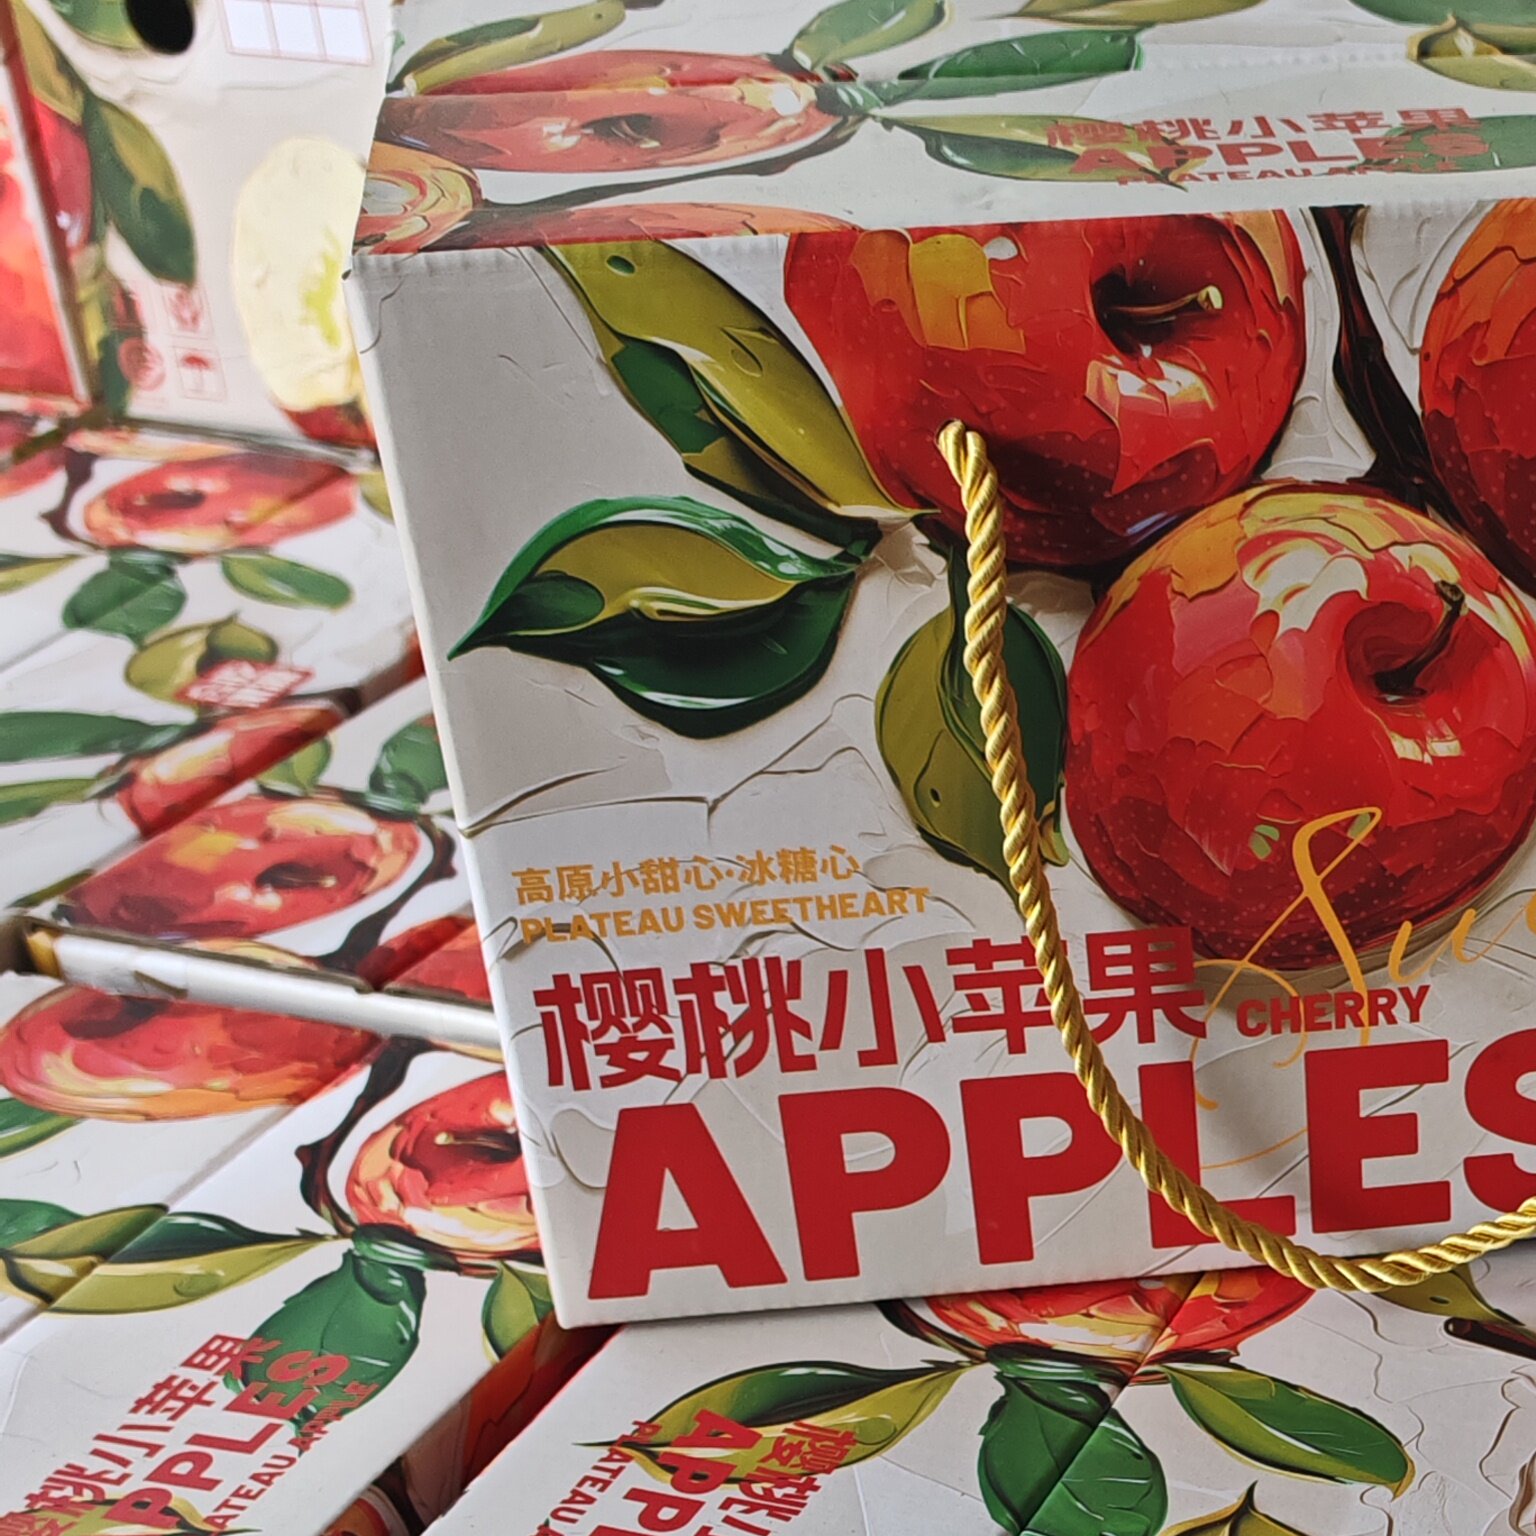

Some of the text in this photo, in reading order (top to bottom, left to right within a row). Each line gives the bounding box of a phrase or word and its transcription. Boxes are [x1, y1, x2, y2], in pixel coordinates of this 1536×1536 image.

[1047, 107, 1482, 148] 樱桃小苹果
[1069, 133, 1490, 174] APPLES
[1116, 167, 1313, 186] PLATEAU
[520, 887, 932, 944] PLATEAU SWEETHEART
[533, 926, 1206, 1092] 樱桃小苹果
[1236, 984, 1431, 1038] CHERRY
[550, 1420, 662, 1524] PLATEAU
